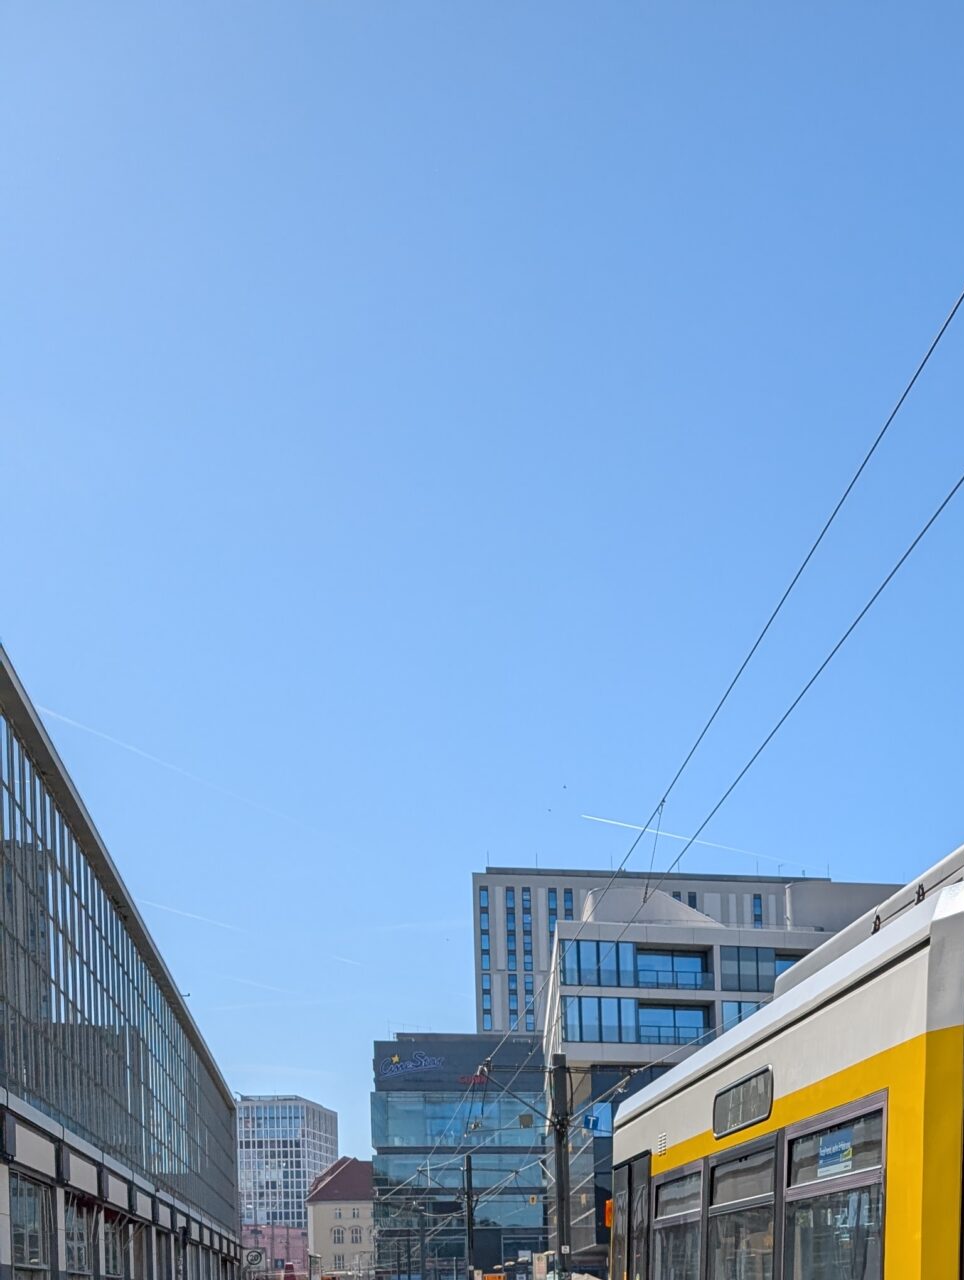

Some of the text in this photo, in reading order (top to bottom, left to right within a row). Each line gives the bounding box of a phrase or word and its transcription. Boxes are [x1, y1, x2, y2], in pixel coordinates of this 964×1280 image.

[380, 1051, 446, 1077] CineStar
[587, 1116, 597, 1129] T
[250, 1254, 259, 1262] 20
